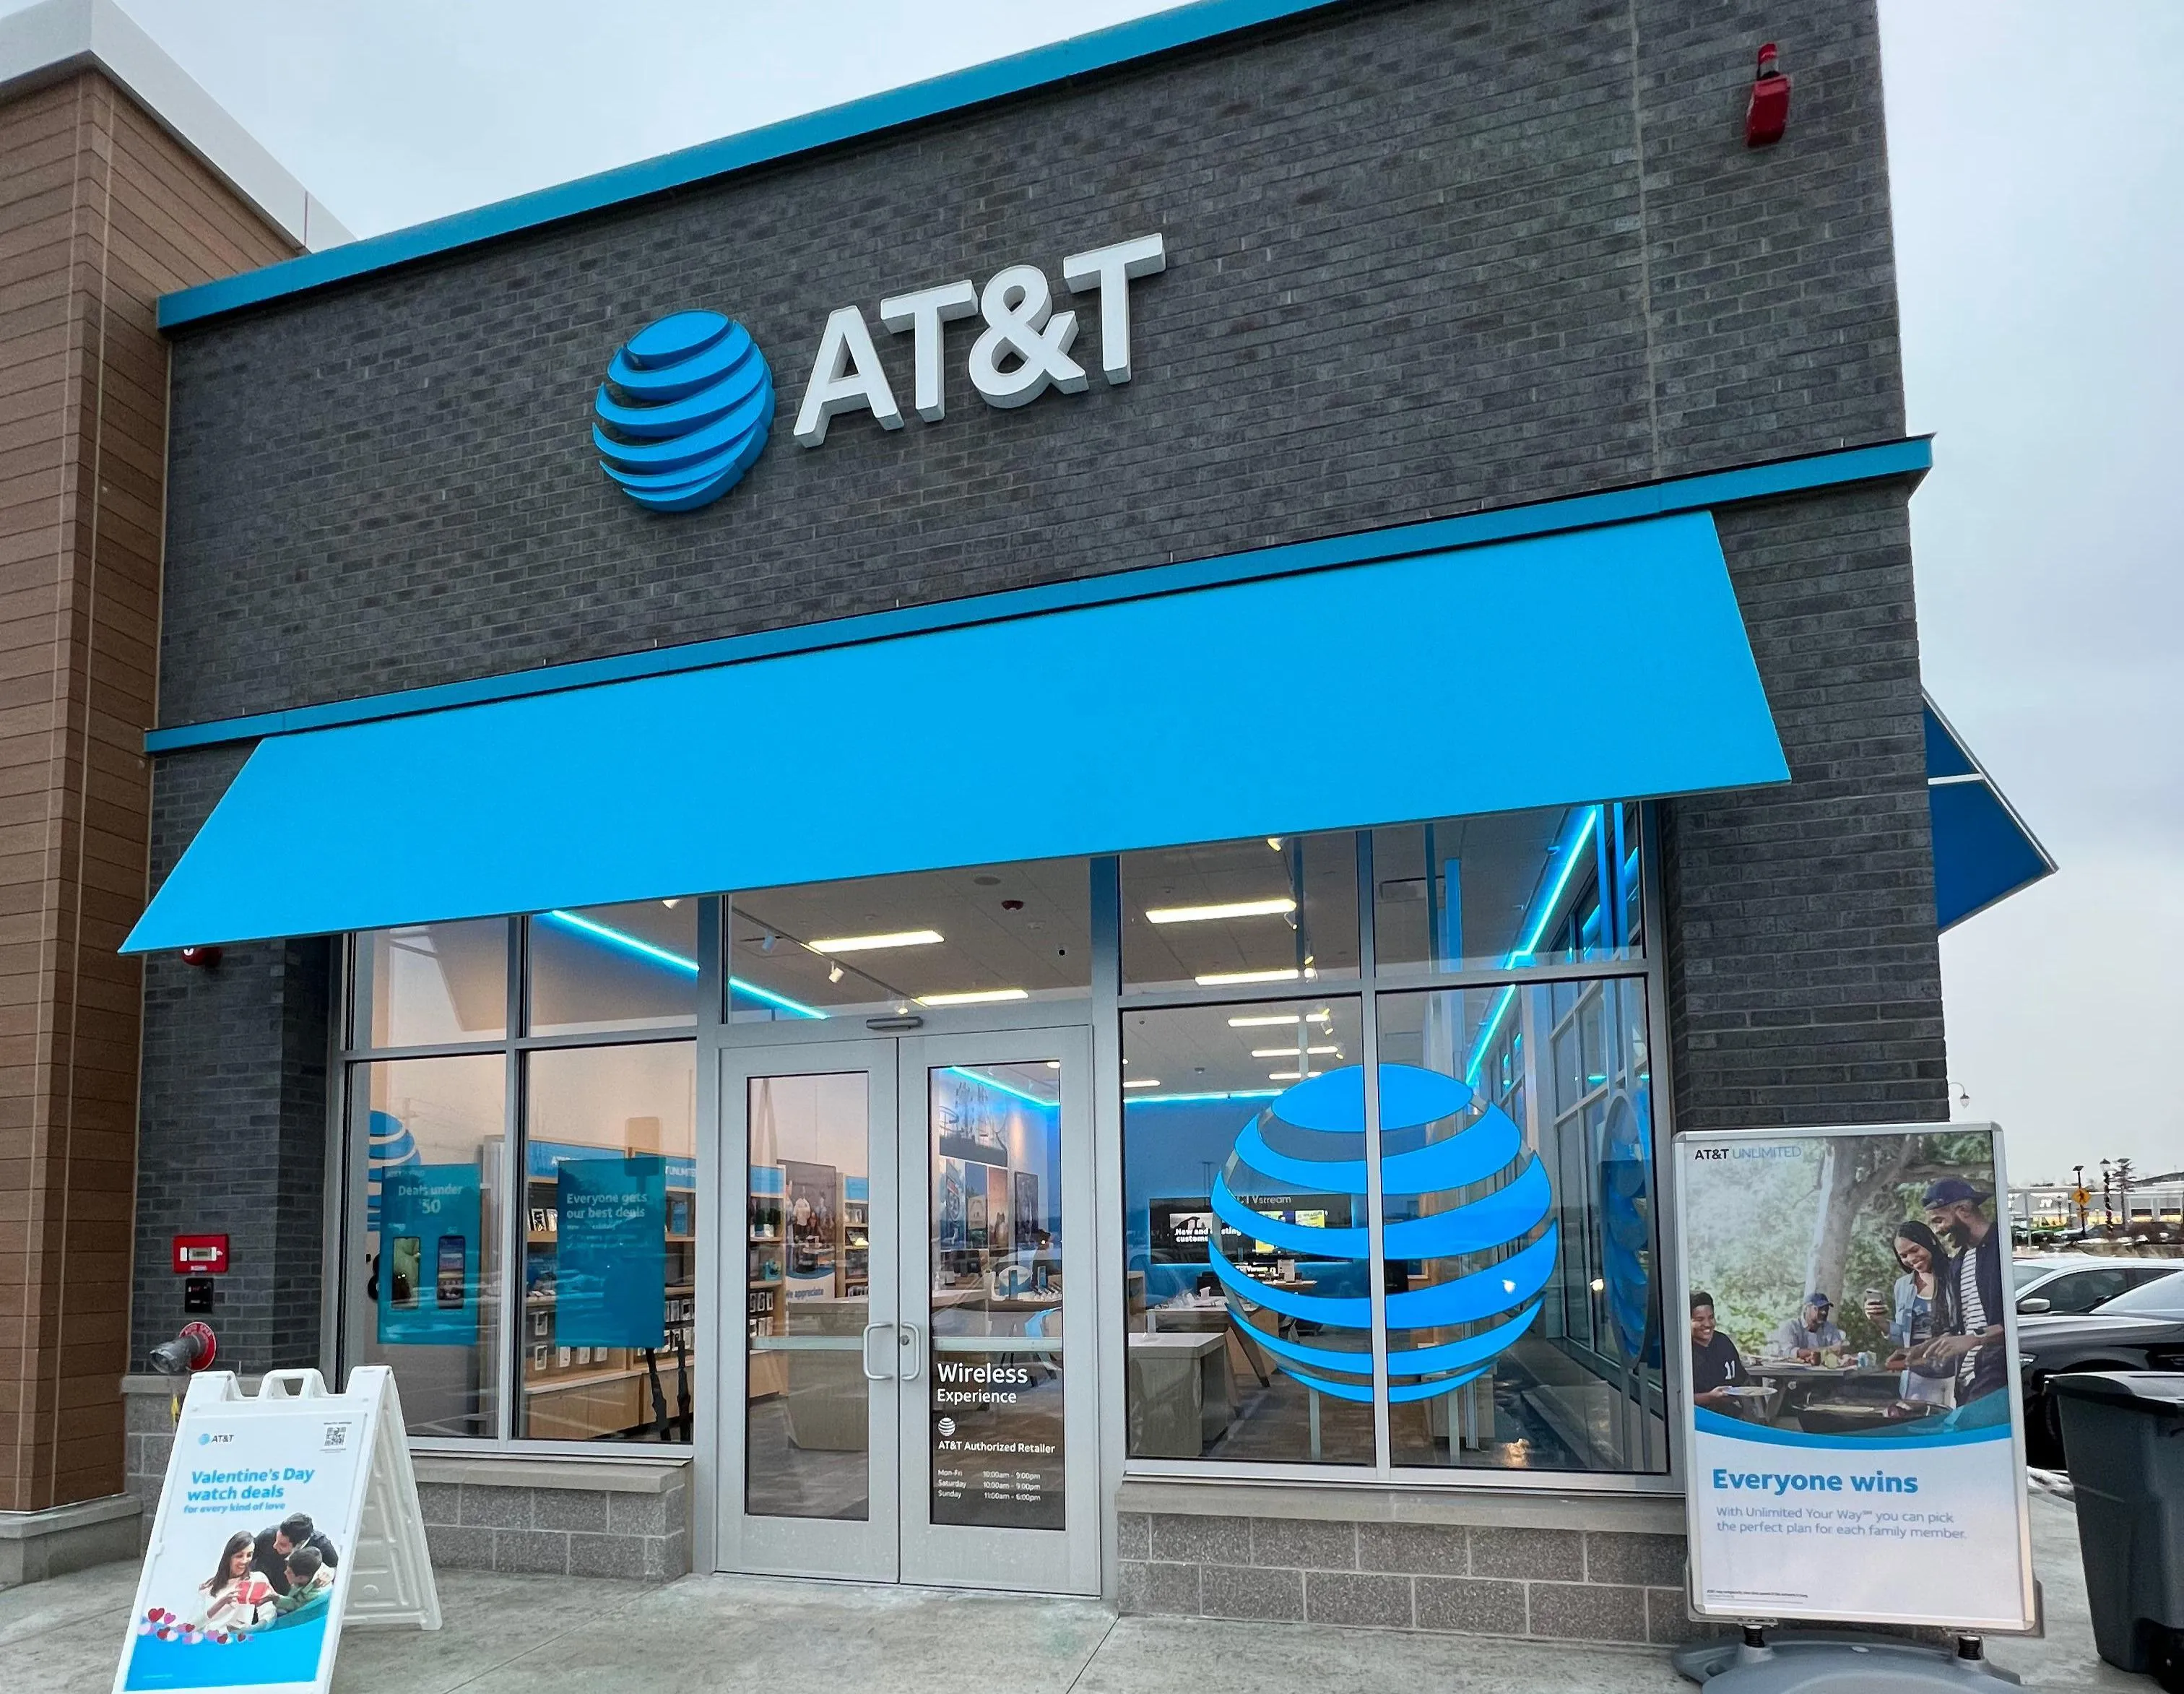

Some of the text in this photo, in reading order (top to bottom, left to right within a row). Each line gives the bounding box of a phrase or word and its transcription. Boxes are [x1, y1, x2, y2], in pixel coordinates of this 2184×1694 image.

[794, 233, 1166, 448] AT&T
[1694, 1146, 1802, 1160] AT&T UNLIMITED
[398, 1183, 464, 1196] Deals under
[567, 1193, 648, 1206] Everyone gets
[566, 1209, 586, 1219] our
[588, 1206, 613, 1218] best
[937, 1362, 1028, 1383] Wireless
[937, 1388, 1017, 1406] Experience
[211, 1434, 235, 1443] AT&T
[938, 1440, 1056, 1453] AT&T Authorized Retailer
[191, 1467, 316, 1485] Valentine's Day
[1712, 1469, 1919, 1496] Everyone wins
[937, 1479, 967, 1489] Saturday
[187, 1485, 285, 1501] watch deals
[937, 1490, 962, 1499] Sunday
[183, 1502, 286, 1514] for every kind of love
[1716, 1506, 1743, 1517] With
[1746, 1507, 1803, 1518] Unlimited
[1806, 1508, 1833, 1519] Your
[1875, 1512, 1898, 1523] you
[1902, 1513, 1925, 1522] can
[1928, 1512, 1954, 1524] pick
[1717, 1521, 1736, 1531] the
[1739, 1521, 1782, 1534] perfect
[1787, 1523, 1812, 1534] plan
[1816, 1523, 1832, 1534] for
[1837, 1525, 1866, 1536] each
[1869, 1524, 1907, 1539] family
